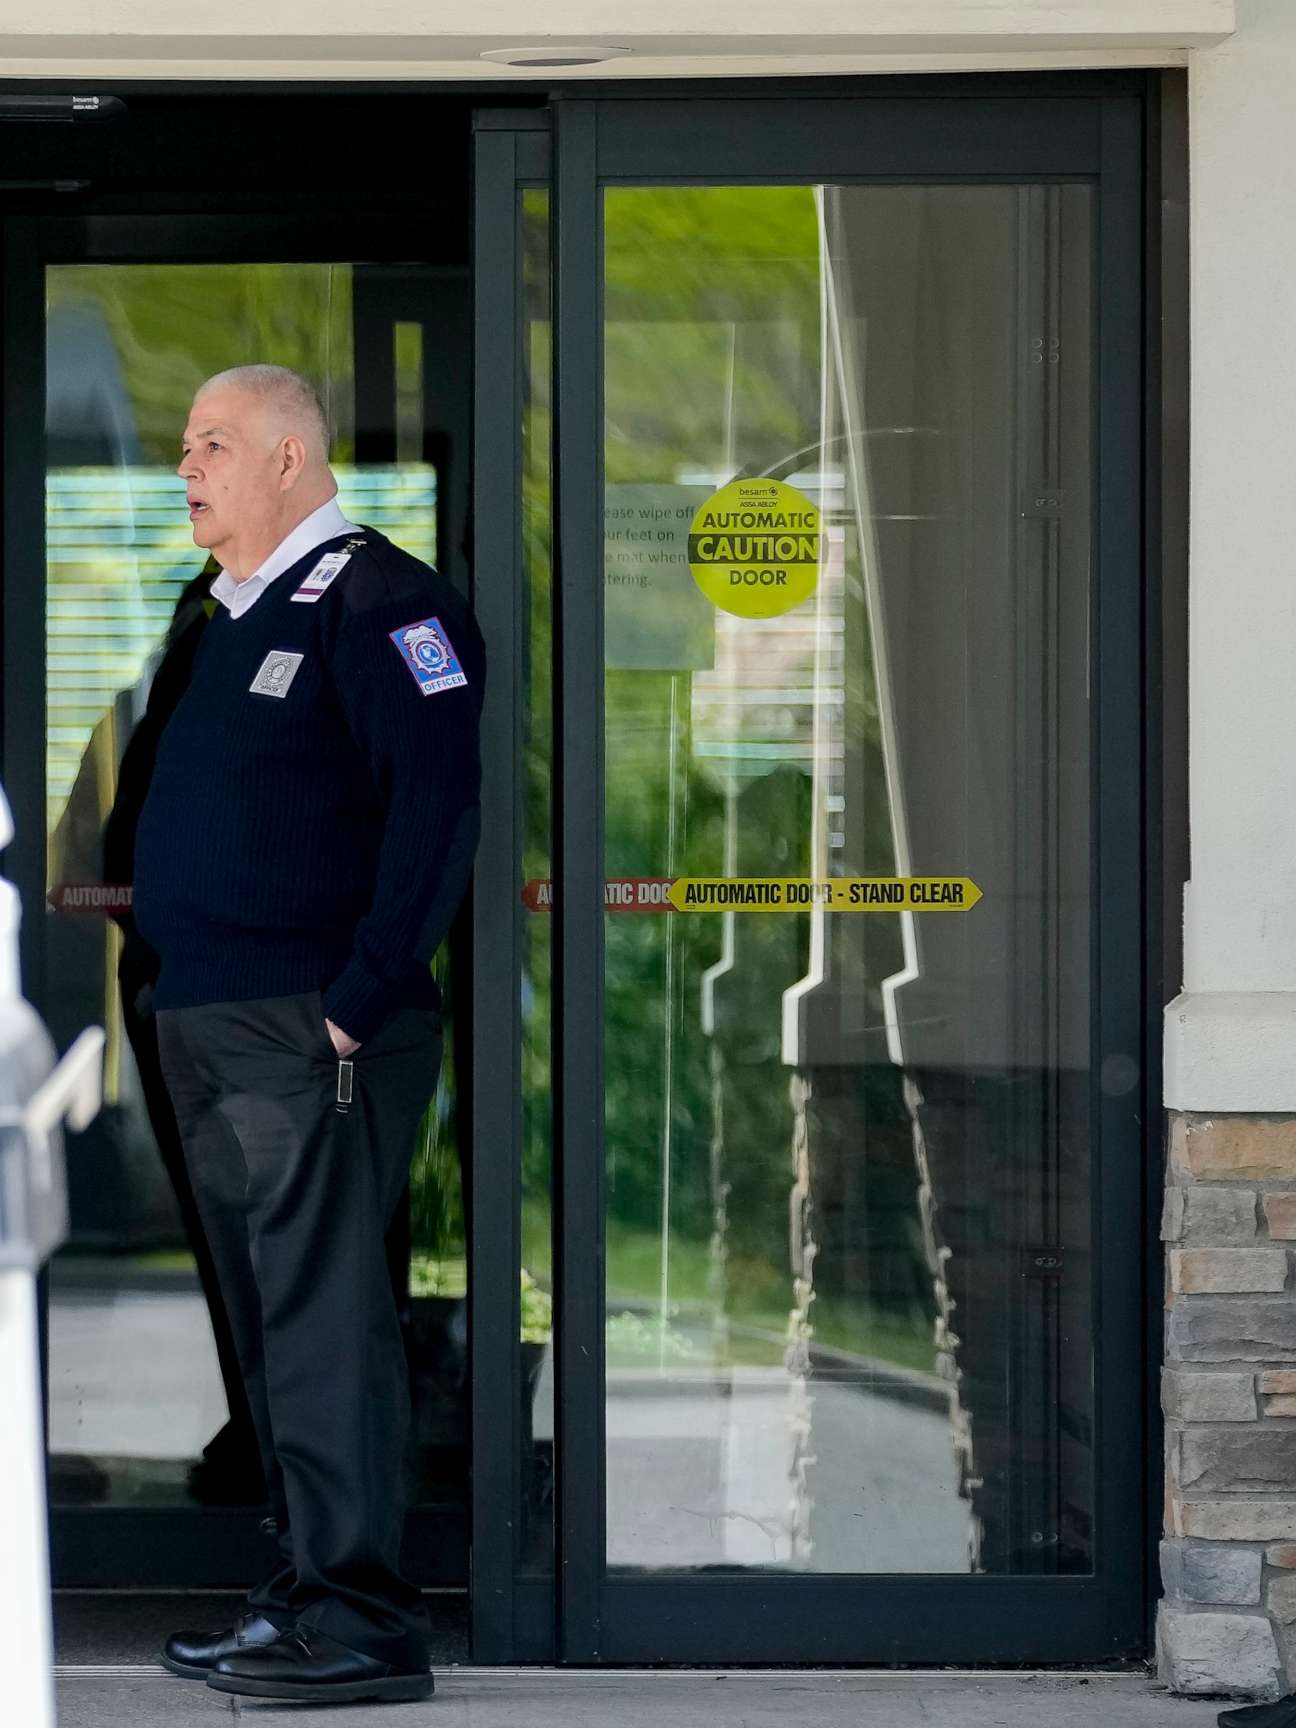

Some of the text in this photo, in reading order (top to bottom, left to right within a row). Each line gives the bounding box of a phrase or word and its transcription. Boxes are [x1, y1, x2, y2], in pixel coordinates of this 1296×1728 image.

[739, 487, 768, 496] besam
[605, 508, 634, 519] ease
[638, 506, 672, 521] wipe
[702, 512, 815, 528] AUTOMATIC
[626, 528, 652, 541] feet
[657, 530, 674, 541] on
[648, 550, 686, 563] when
[697, 536, 821, 561] CAUTION
[729, 569, 788, 585] DOOR
[424, 675, 464, 692] OFFICER
[63, 886, 133, 907] AUTOMAT
[637, 883, 672, 904] DOO
[685, 883, 781, 904] AUTOMATIC
[849, 883, 905, 904] STAND
[910, 883, 964, 904] CLEAR
